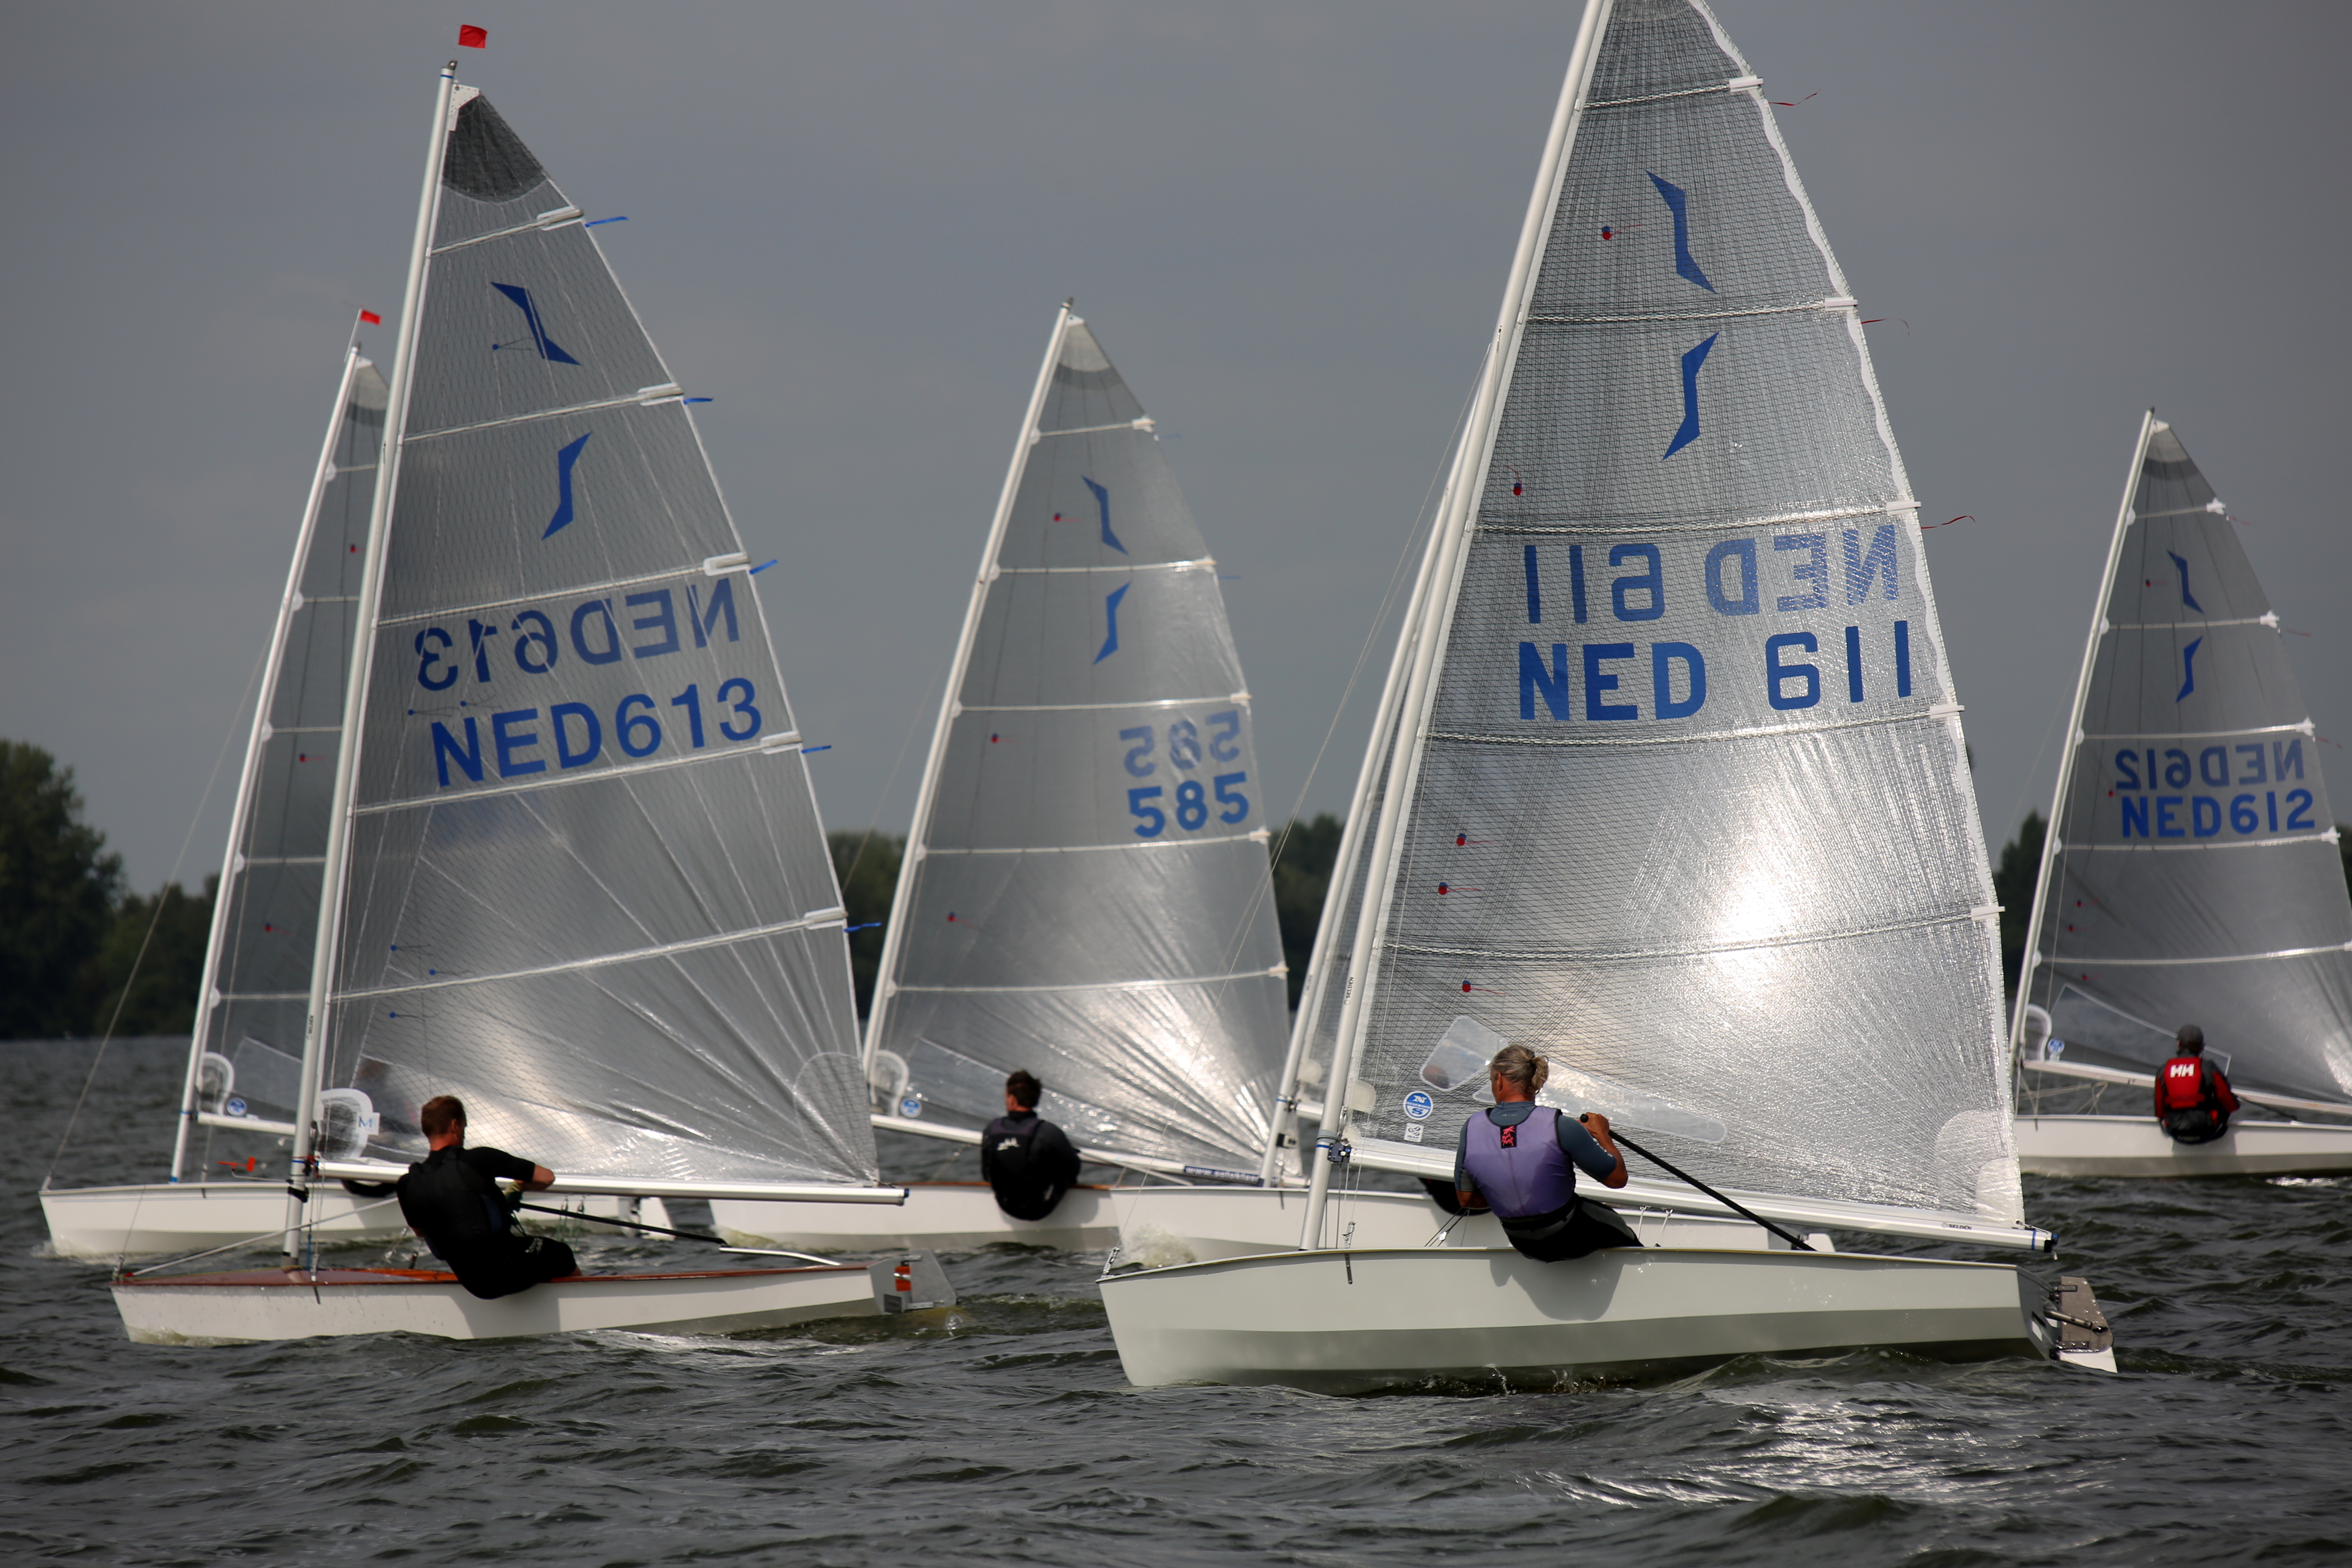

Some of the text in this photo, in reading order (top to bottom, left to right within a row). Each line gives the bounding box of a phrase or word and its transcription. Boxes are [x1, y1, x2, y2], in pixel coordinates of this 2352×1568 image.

[1519, 620, 1912, 722] NED 611
[1127, 771, 1250, 838] 585
[2170, 1063, 2195, 1078] HH
